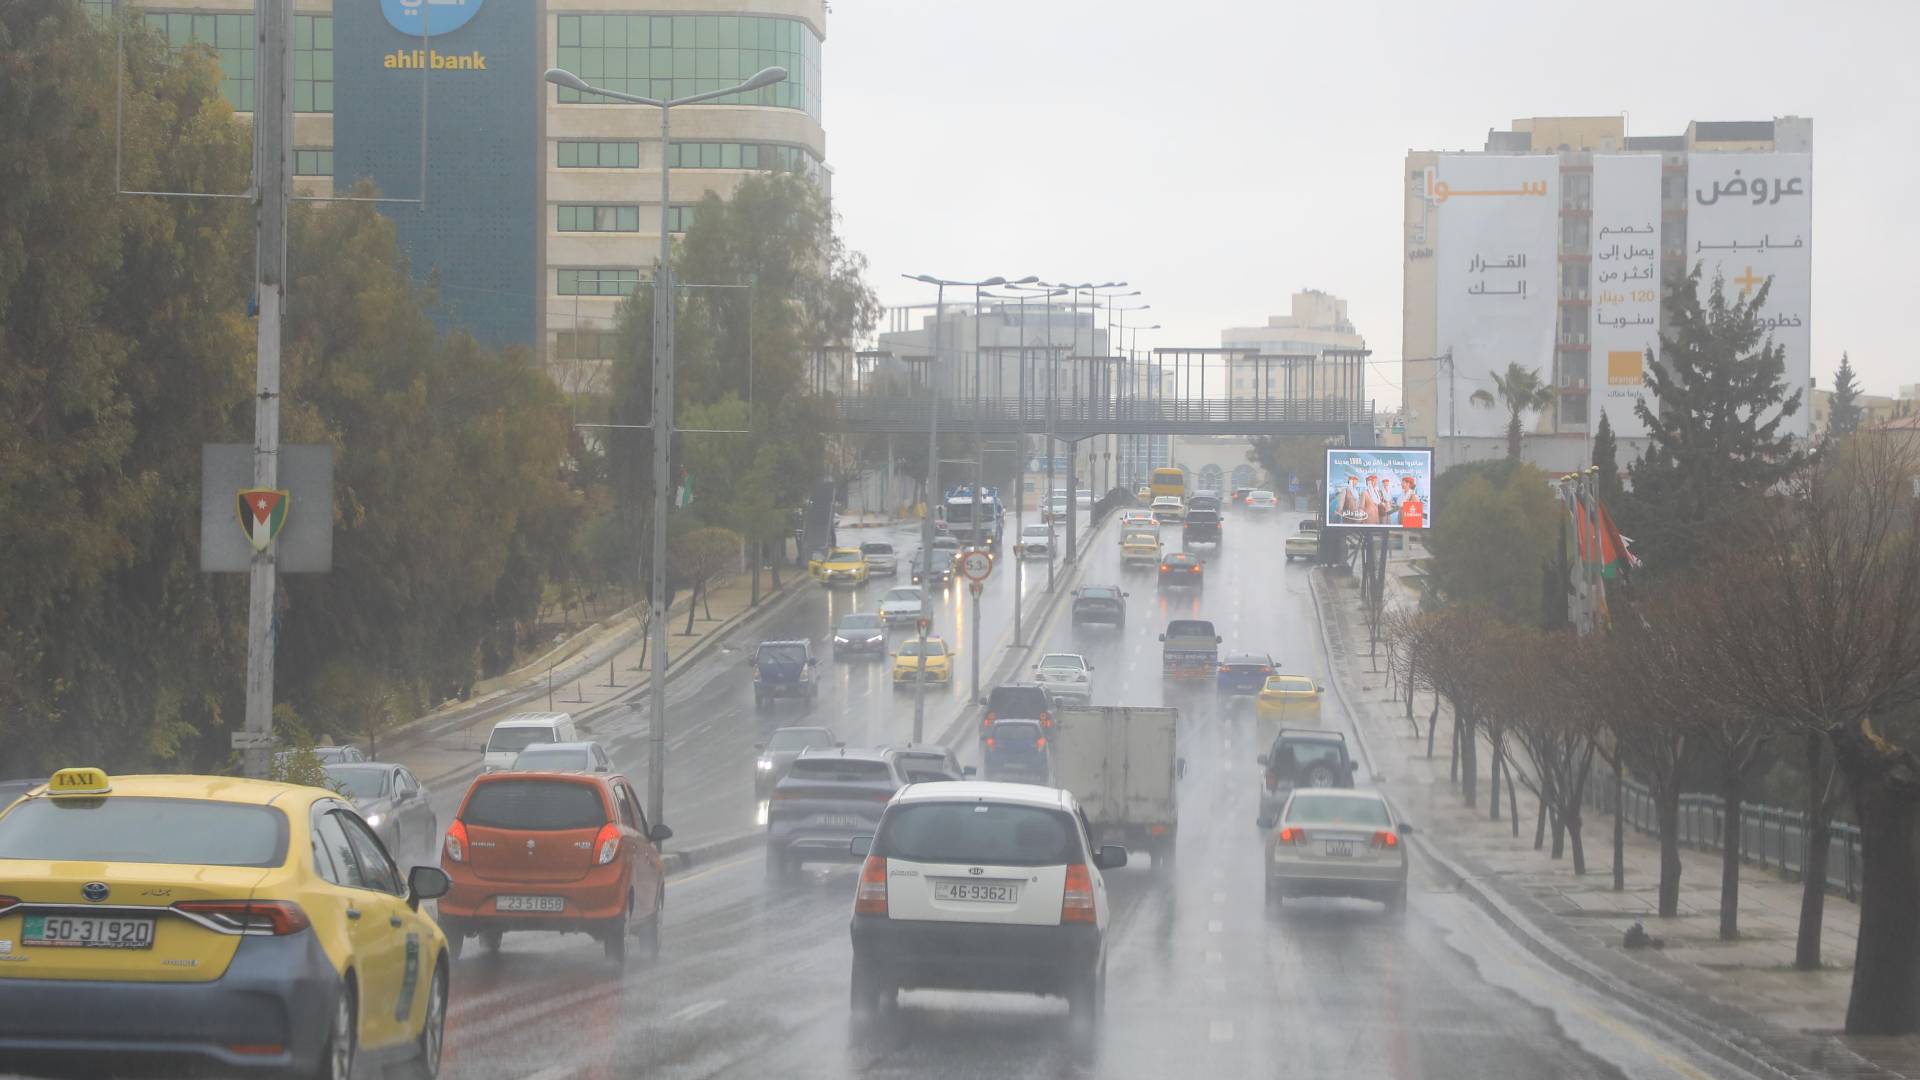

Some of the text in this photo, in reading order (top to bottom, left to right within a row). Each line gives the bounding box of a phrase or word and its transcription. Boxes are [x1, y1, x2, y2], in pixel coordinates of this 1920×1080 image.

[383, 49, 488, 70] ahli bank
[1426, 170, 1548, 203] سوا
[1695, 169, 1804, 206] عروض
[1599, 222, 1655, 240] خصم
[1598, 244, 1655, 261] يصل إلى
[1695, 234, 1804, 254] فايبر
[1467, 253, 1527, 273] القرار
[1598, 265, 1654, 283] أكثر من
[1599, 289, 1655, 305] 120 دينار
[56, 772, 94, 786] TAXI
